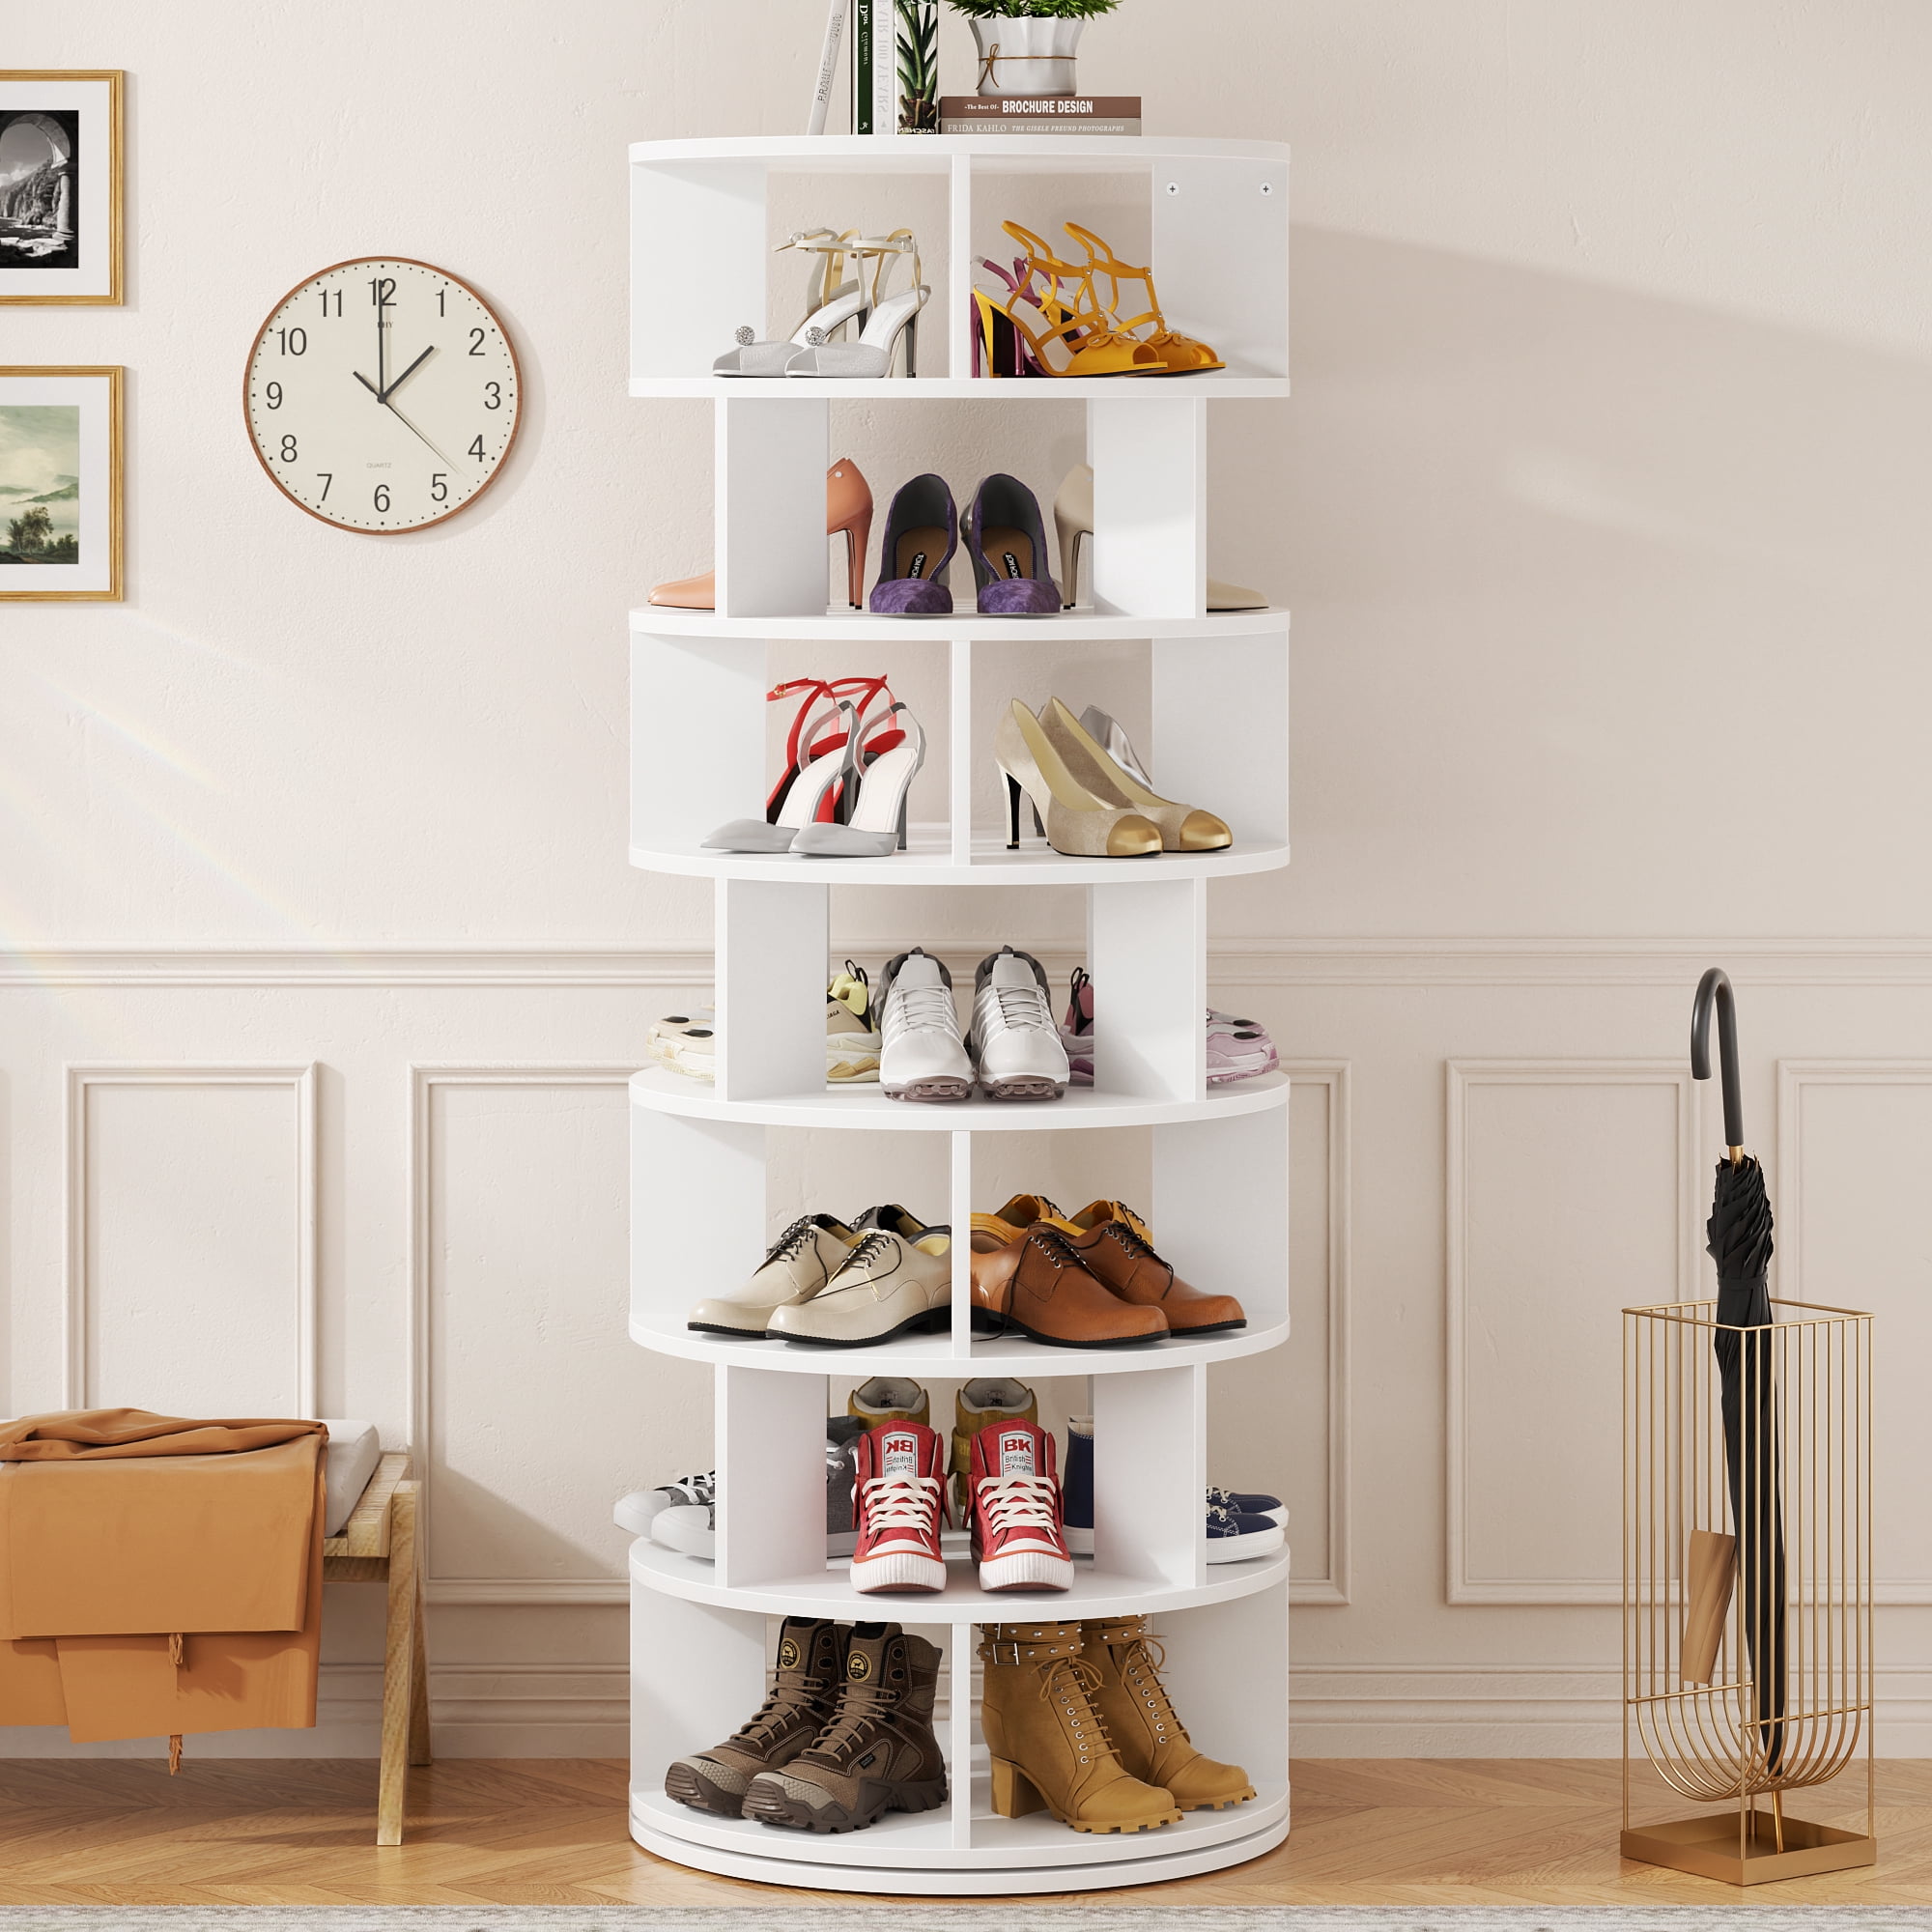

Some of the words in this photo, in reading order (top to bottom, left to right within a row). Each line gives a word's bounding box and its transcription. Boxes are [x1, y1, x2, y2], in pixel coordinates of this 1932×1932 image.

[1002, 99, 1056, 114] BROCHURE
[1057, 99, 1094, 114] DESIGN
[948, 124, 974, 132] FRIDA
[976, 124, 1007, 132] KAHLO
[318, 289, 342, 318] 11
[367, 277, 397, 306] 12
[436, 289, 444, 318] 1
[276, 327, 307, 356] 10
[469, 327, 486, 356] 2
[266, 382, 283, 410] 9
[484, 382, 501, 410] 3
[280, 434, 298, 463] 8
[468, 434, 487, 463] 4
[316, 473, 332, 501] 7
[374, 484, 390, 513] 6
[431, 473, 448, 501] 5
[1004, 1438, 1032, 1453] BK
